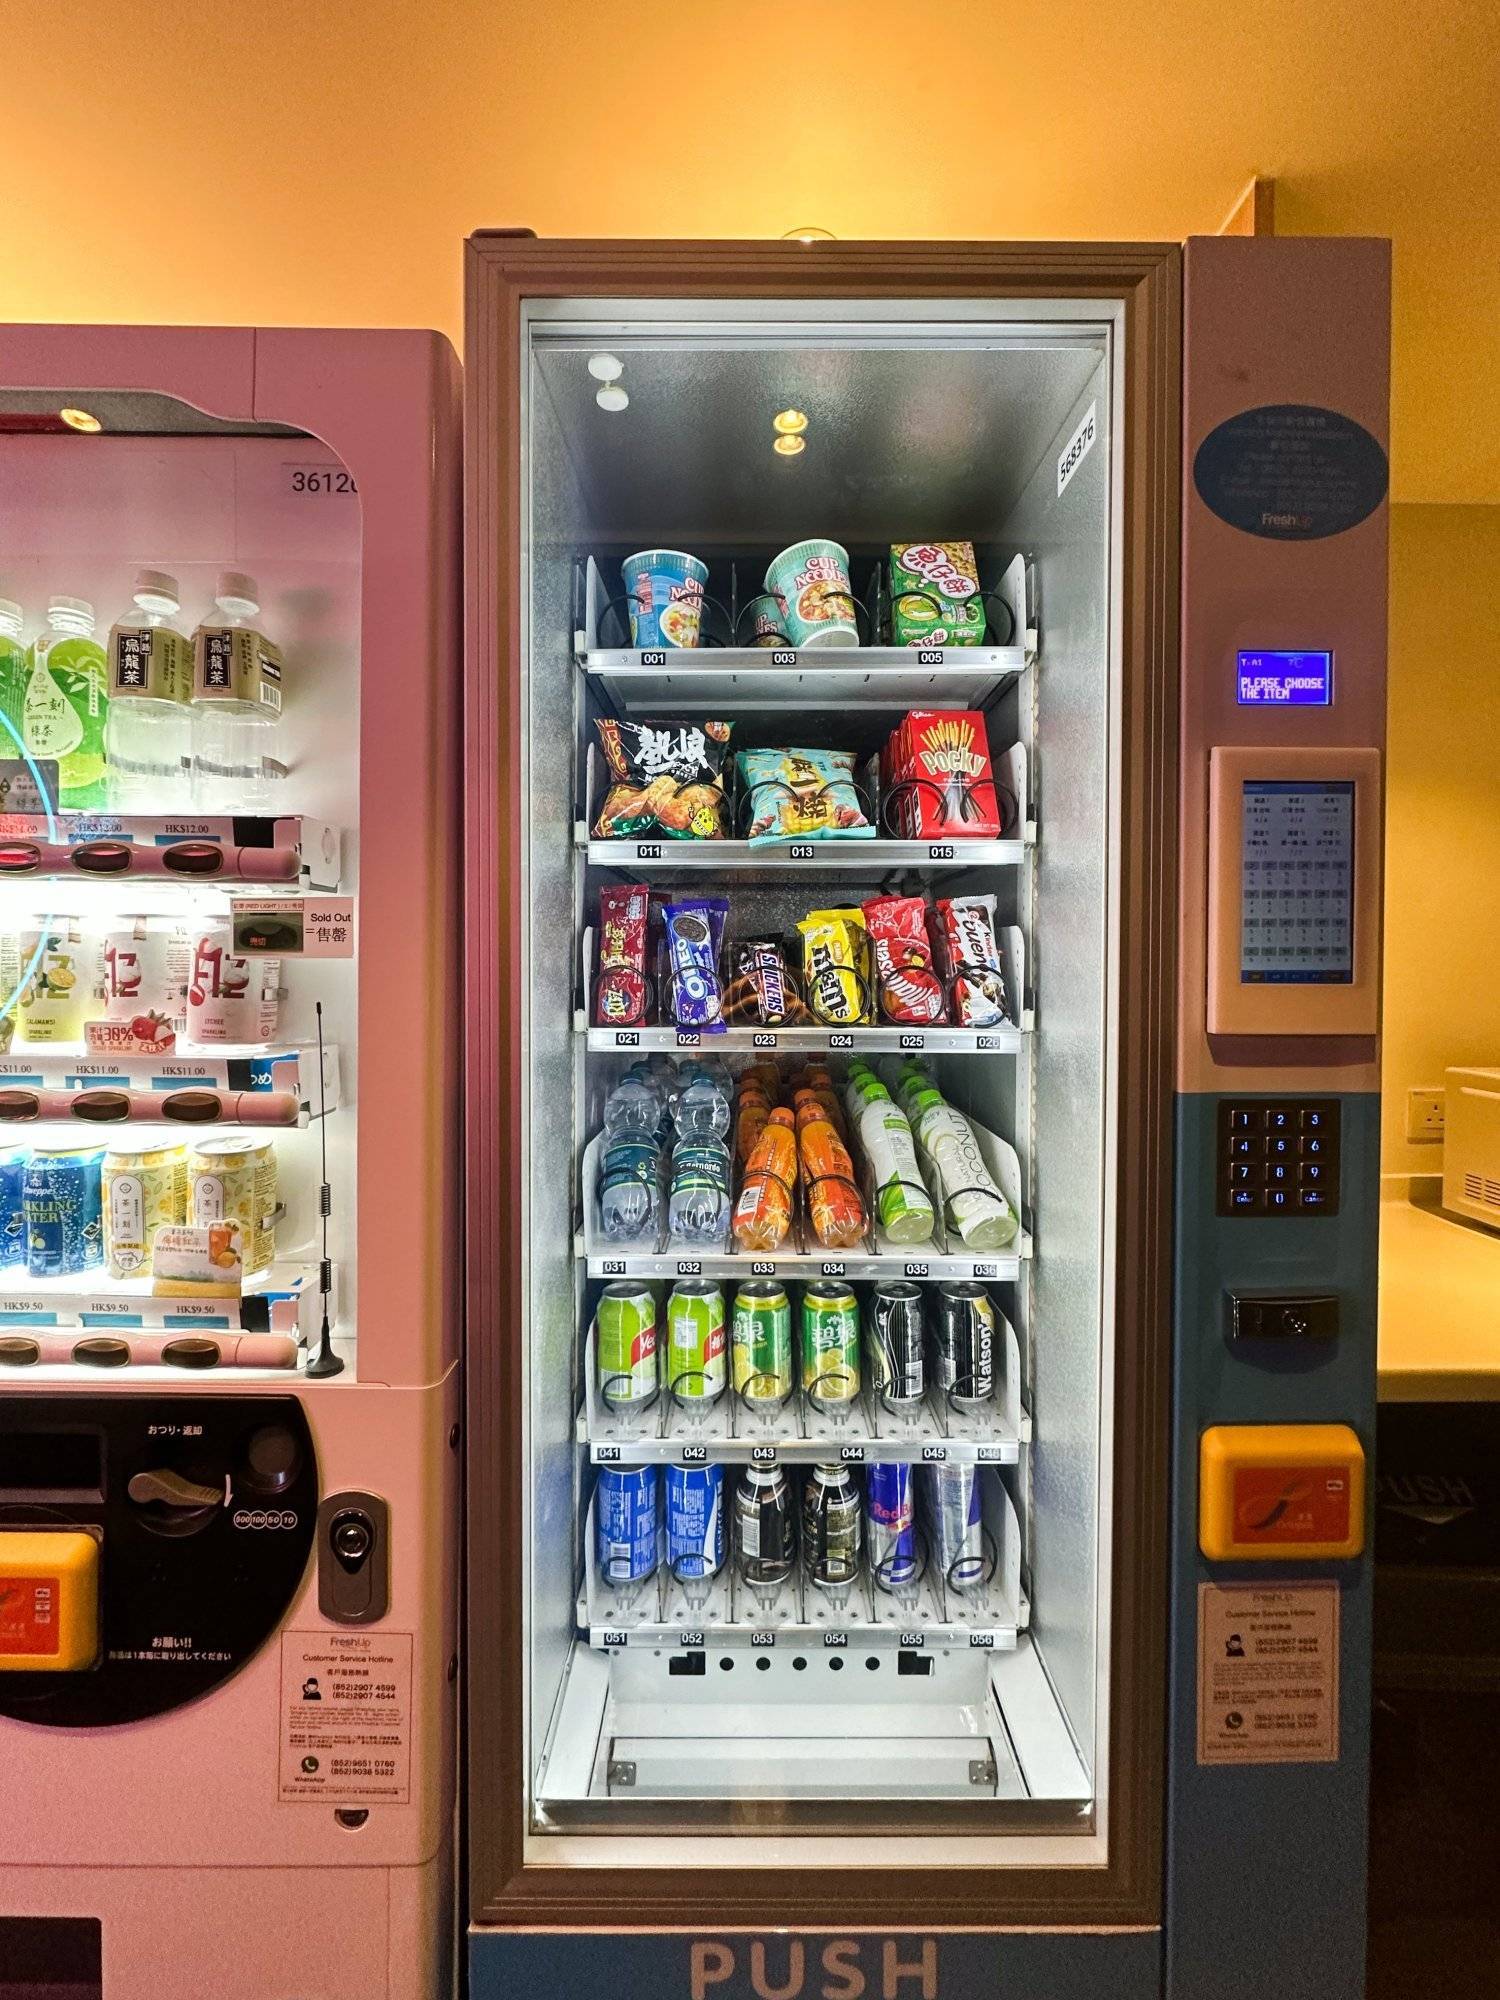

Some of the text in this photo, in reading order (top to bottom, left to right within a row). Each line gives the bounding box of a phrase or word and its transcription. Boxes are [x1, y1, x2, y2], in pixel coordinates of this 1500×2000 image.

[1060, 417, 1094, 482] 568376
[124, 638, 140, 684] 烏龍茶
[209, 638, 224, 684] 烏龍茶
[643, 653, 664, 664] 001
[773, 653, 795, 664] 003
[920, 652, 942, 663] 005
[1240, 676, 1325, 690] PLEASE CHOOSE
[1241, 687, 1290, 700] THE ITEM
[164, 824, 209, 834] HK$12.00
[640, 846, 660, 857] 011
[791, 846, 813, 858] 013
[931, 846, 952, 858] 015
[310, 912, 351, 922] Sold Out
[676, 938, 708, 1000] OREO
[606, 988, 627, 1017] RITZ
[618, 1033, 638, 1044] 021
[678, 1034, 700, 1045] 022
[754, 1034, 776, 1045] 023
[830, 1035, 853, 1046] 024
[901, 1036, 923, 1047] 025
[977, 1037, 999, 1048] 026
[75, 1064, 119, 1075] HK$11.00
[162, 1065, 206, 1076] HK$11.00
[1242, 1113, 1248, 1125] 1
[1277, 1114, 1285, 1125] 2
[1311, 1114, 1319, 1125] 3
[1240, 1141, 1249, 1152] 4
[1277, 1141, 1285, 1151] 5
[1311, 1141, 1320, 1151] 6
[1241, 1167, 1249, 1178] 7
[1276, 1167, 1284, 1178] 8
[1310, 1167, 1319, 1178] 9
[1275, 1193, 1284, 1204] 0
[604, 1262, 625, 1272] 031
[678, 1262, 700, 1273] 032
[753, 1263, 775, 1273] 033
[823, 1264, 844, 1274] 034
[906, 1264, 928, 1274] 035
[975, 1265, 996, 1275] 036
[4, 1301, 43, 1311] HK$9.50
[91, 1302, 129, 1313] HK$9.50
[176, 1304, 215, 1315] HK$9.50
[599, 1448, 619, 1458] 041
[684, 1448, 705, 1458] 042
[753, 1448, 775, 1458] 043
[841, 1448, 863, 1459] 044
[924, 1448, 945, 1459] 045
[979, 1448, 999, 1458] 046
[873, 1503, 902, 1521] Red
[251, 1515, 266, 1525] 100
[267, 1515, 280, 1525] 50
[283, 1515, 294, 1525] 10
[605, 1633, 626, 1643] 051
[681, 1633, 703, 1643] 052
[752, 1633, 774, 1643] 053
[825, 1634, 846, 1645] 054
[901, 1634, 923, 1645] 055
[971, 1634, 992, 1645] 056
[302, 1654, 394, 1663] Customer Service Hotline
[332, 1683, 374, 1692] (852)2907
[332, 1691, 373, 1701] (852)2907
[689, 1938, 938, 2000] PUSH
